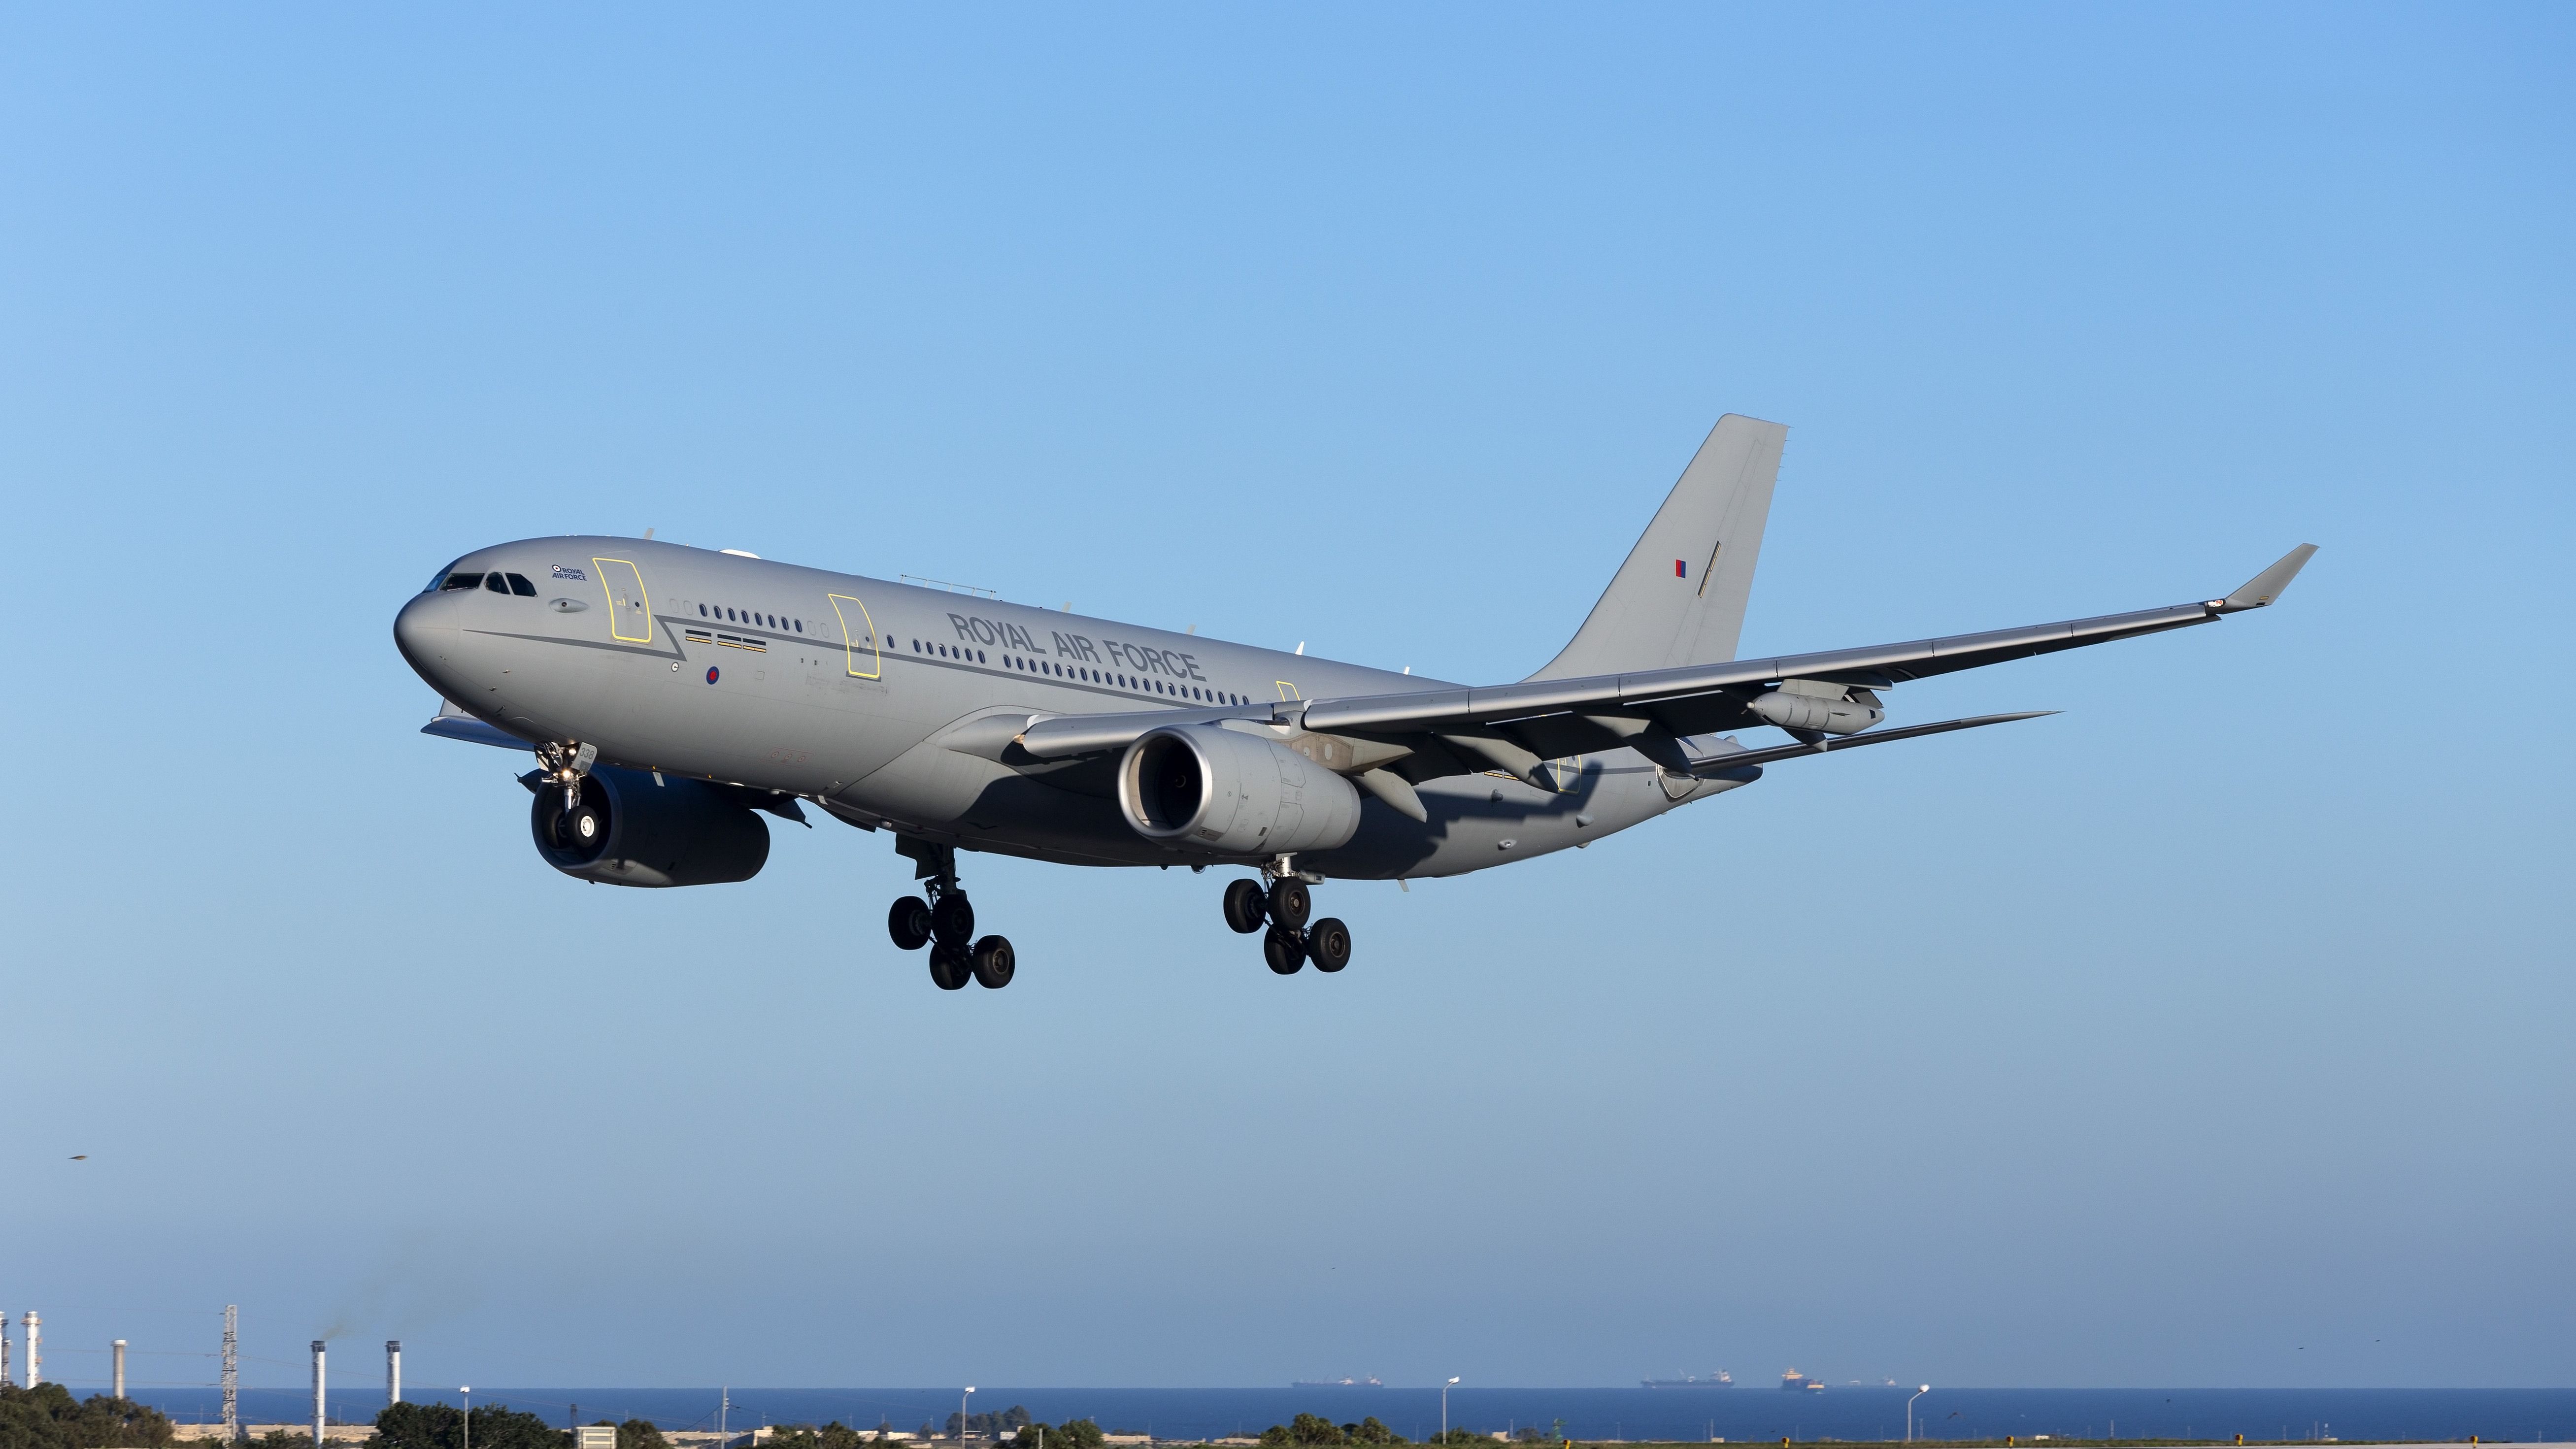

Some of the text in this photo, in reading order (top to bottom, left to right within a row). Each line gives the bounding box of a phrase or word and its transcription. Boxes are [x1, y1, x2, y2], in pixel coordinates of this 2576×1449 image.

[946, 613, 1207, 682] ROYAL AIR FORCE
[580, 748, 594, 759] 338
